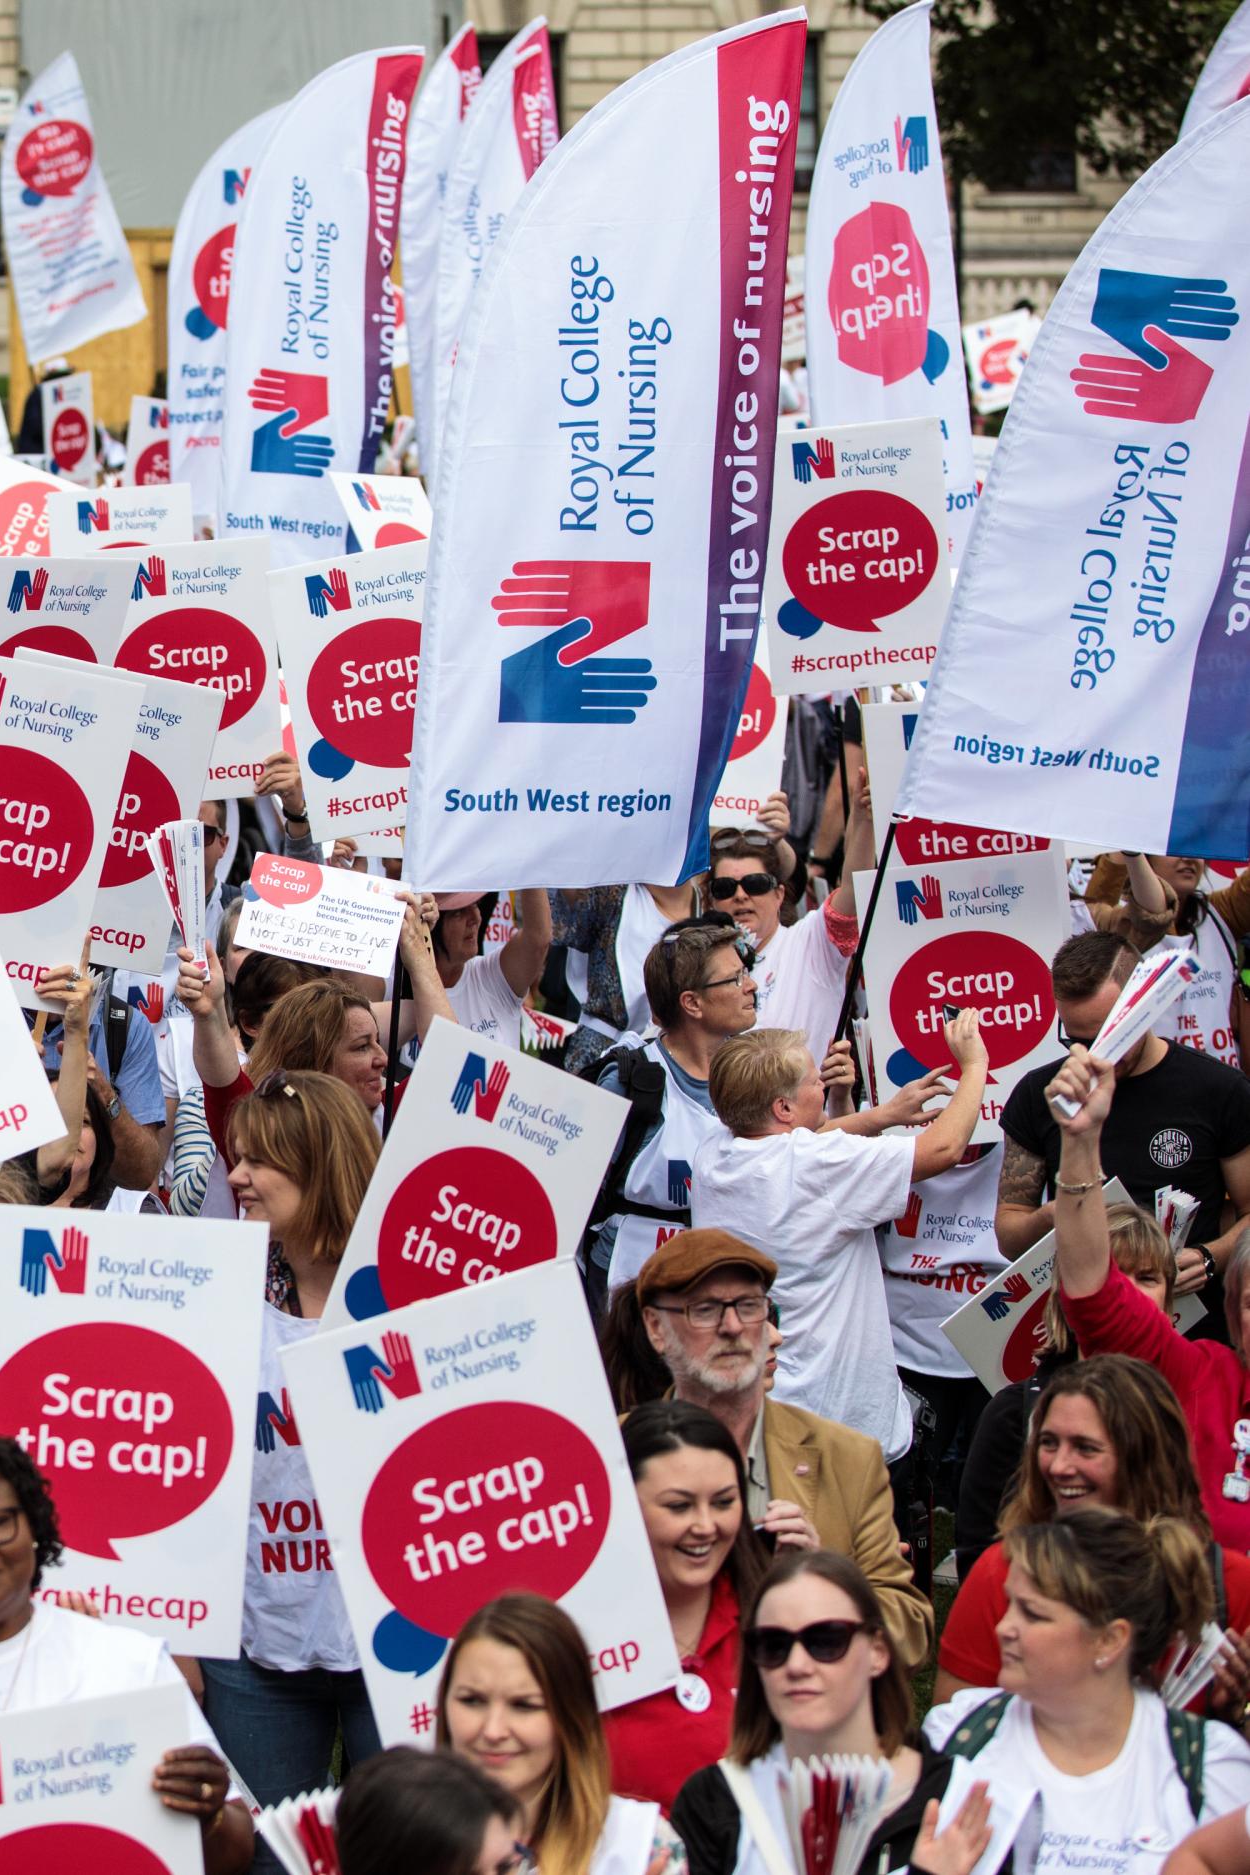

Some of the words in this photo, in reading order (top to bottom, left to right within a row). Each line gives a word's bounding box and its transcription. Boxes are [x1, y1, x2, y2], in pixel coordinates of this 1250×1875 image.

[372, 92, 407, 230] nursing
[735, 95, 790, 306] nursing
[285, 176, 313, 274] College
[374, 229, 393, 269] of
[310, 222, 339, 321] Nursing
[281, 282, 305, 355] Royal
[559, 255, 614, 407] College
[306, 328, 329, 360] of
[734, 318, 761, 376] of
[181, 364, 207, 379] Fair
[186, 384, 223, 399] safer
[368, 370, 392, 438] The
[617, 317, 672, 478] Nursing
[724, 391, 759, 536] voice
[841, 449, 870, 465] Royal
[872, 444, 911, 462] College
[842, 465, 854, 477] of
[856, 464, 897, 477] Nursing
[558, 420, 614, 532] Royal
[226, 512, 263, 530] South
[269, 514, 301, 535] West
[302, 516, 344, 541] region
[614, 489, 654, 536] of
[817, 526, 900, 554] Scrap
[172, 568, 199, 583] Royal
[203, 565, 242, 581] College
[354, 576, 386, 597] Royal
[387, 569, 426, 589] College
[806, 561, 856, 585] the
[863, 549, 924, 582] cap!
[49, 585, 72, 600] Royal
[75, 585, 107, 600] College
[172, 583, 183, 595] of
[186, 581, 227, 596] Nursing
[357, 594, 370, 607] of
[371, 587, 415, 607] Nursing
[719, 548, 760, 652] The
[45, 600, 56, 611] of
[57, 601, 91, 615] Nursing
[148, 643, 228, 675] Scrap
[791, 645, 938, 674] #scrapthecap
[9, 694, 47, 719] Royal
[49, 702, 98, 726] College
[4, 713, 22, 729] of
[23, 716, 73, 743] Nursing
[444, 789, 518, 812] South
[526, 789, 590, 812] West
[597, 788, 672, 817] region
[260, 873, 280, 887] the
[283, 880, 310, 894] cap!
[270, 862, 306, 879] Scrap
[320, 894, 335, 904] The
[338, 897, 349, 907] UK
[351, 901, 400, 917] Government
[948, 888, 981, 905] Royal
[982, 883, 1025, 900] College
[949, 905, 962, 918] of
[964, 901, 1010, 917] Nursing
[250, 909, 297, 931] NURSES
[298, 919, 341, 938] DESERVE
[344, 931, 357, 942] TO
[360, 931, 392, 949] LIVE
[318, 904, 338, 914] must
[340, 907, 394, 926] #scrapthecap
[250, 927, 279, 943] NOT
[282, 934, 313, 948] JUST
[259, 942, 367, 970] www.rcn.org.uk/scrapthecap
[926, 970, 1014, 1005] Scrap
[1178, 1015, 1198, 1030] THE
[507, 1093, 540, 1123] Royal
[539, 1104, 584, 1140] College
[499, 1115, 516, 1131] of
[514, 1121, 559, 1156] Nursing
[1154, 1131, 1188, 1145] BROOKLYN
[1153, 1151, 1188, 1167] THUNDER
[431, 1185, 523, 1255] Scrap
[401, 1226, 456, 1275] the
[98, 1256, 144, 1284] Royal
[151, 1259, 213, 1285] College
[96, 1282, 115, 1298] of
[119, 1284, 184, 1308] Nursing
[425, 1337, 468, 1368] Royal
[474, 1318, 536, 1350] College
[431, 1367, 452, 1388] of
[453, 1351, 520, 1382] Nursing
[42, 1373, 174, 1434] Scrap
[15, 1425, 94, 1469] the
[108, 1435, 207, 1487] cap!
[412, 1455, 544, 1523] Scrap
[404, 1533, 487, 1582] the
[496, 1484, 593, 1552] cap!
